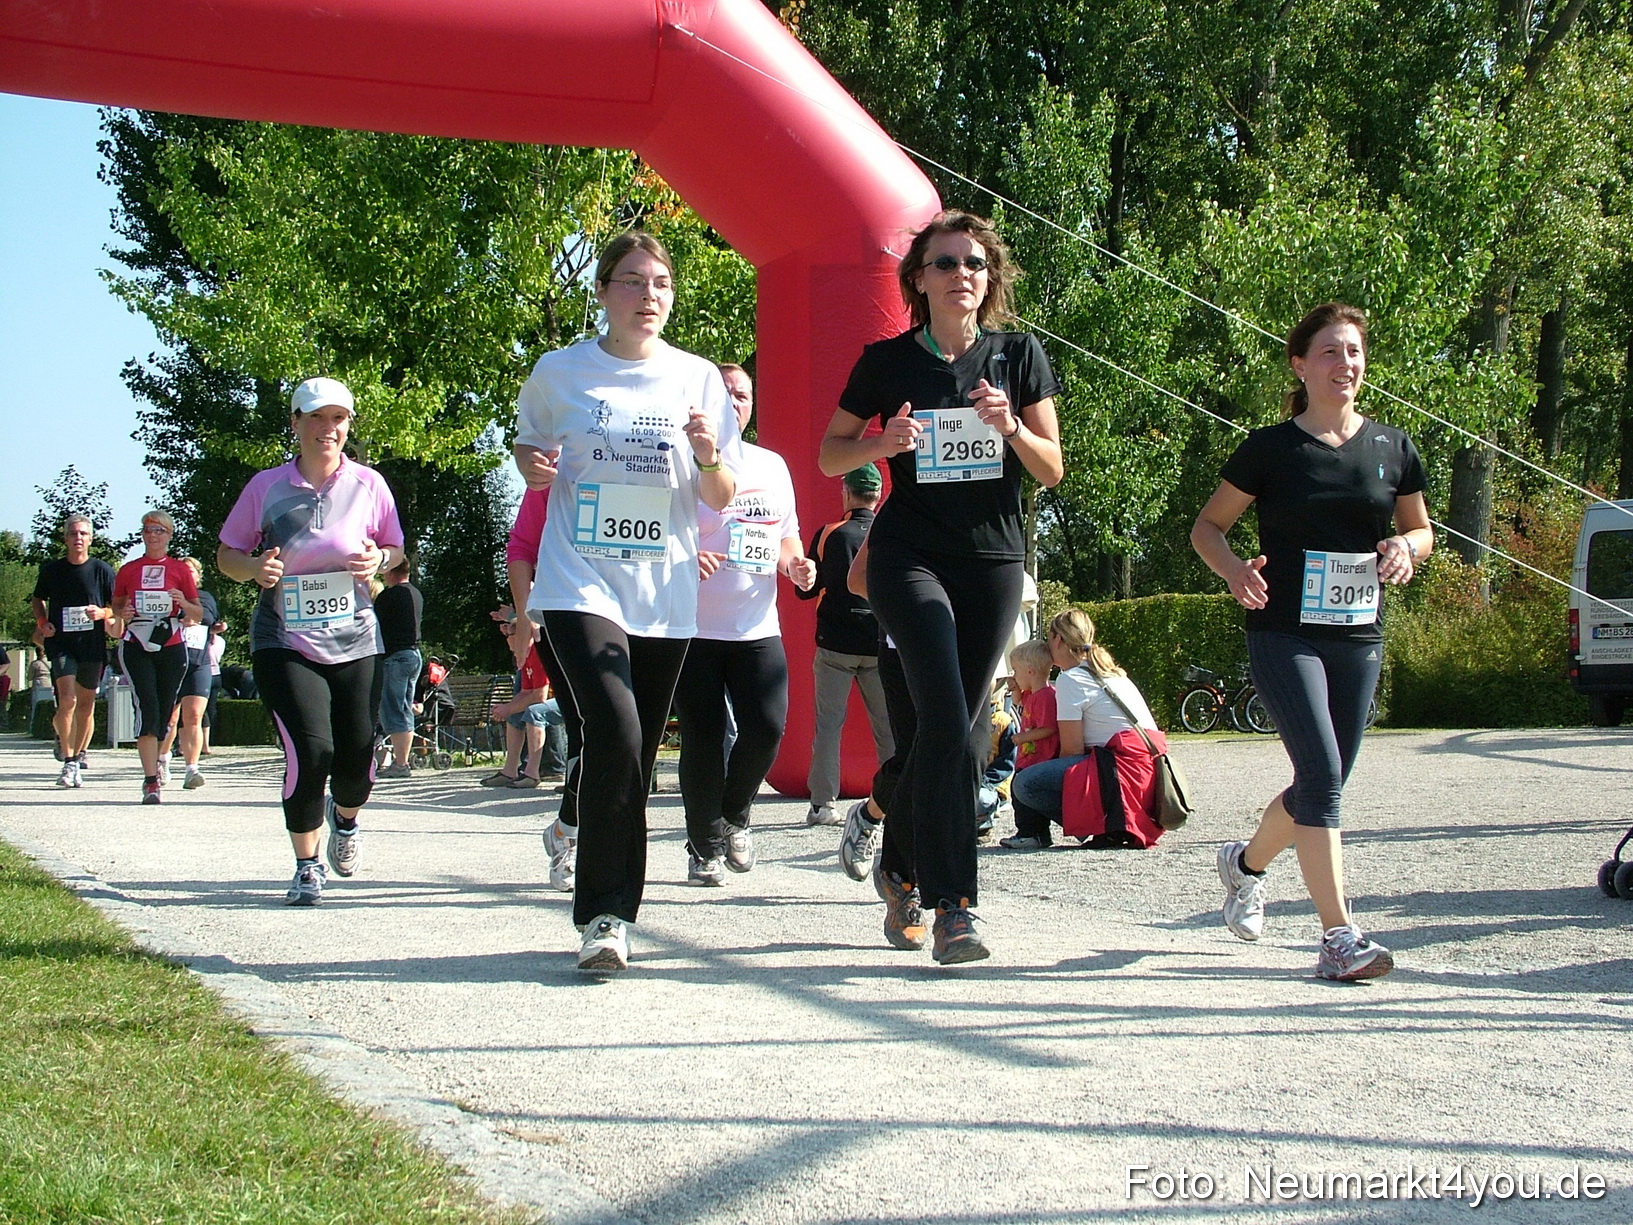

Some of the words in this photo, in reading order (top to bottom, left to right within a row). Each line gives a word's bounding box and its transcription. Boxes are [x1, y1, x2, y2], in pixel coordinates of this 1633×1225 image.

[938, 416, 962, 432] Inge
[593, 448, 608, 461] 8.
[611, 453, 670, 465] Neumarkte
[942, 439, 996, 461] 2963
[972, 467, 1002, 475] PFLEIDERER
[603, 517, 662, 541] 3606
[631, 549, 665, 558] PFLEIDERER
[1330, 559, 1367, 574] Theresa
[302, 579, 328, 591] Babsi
[1329, 585, 1374, 605] 3019
[146, 603, 169, 612] 3057
[305, 596, 349, 615] 3399
[1613, 628, 1624, 636] BS
